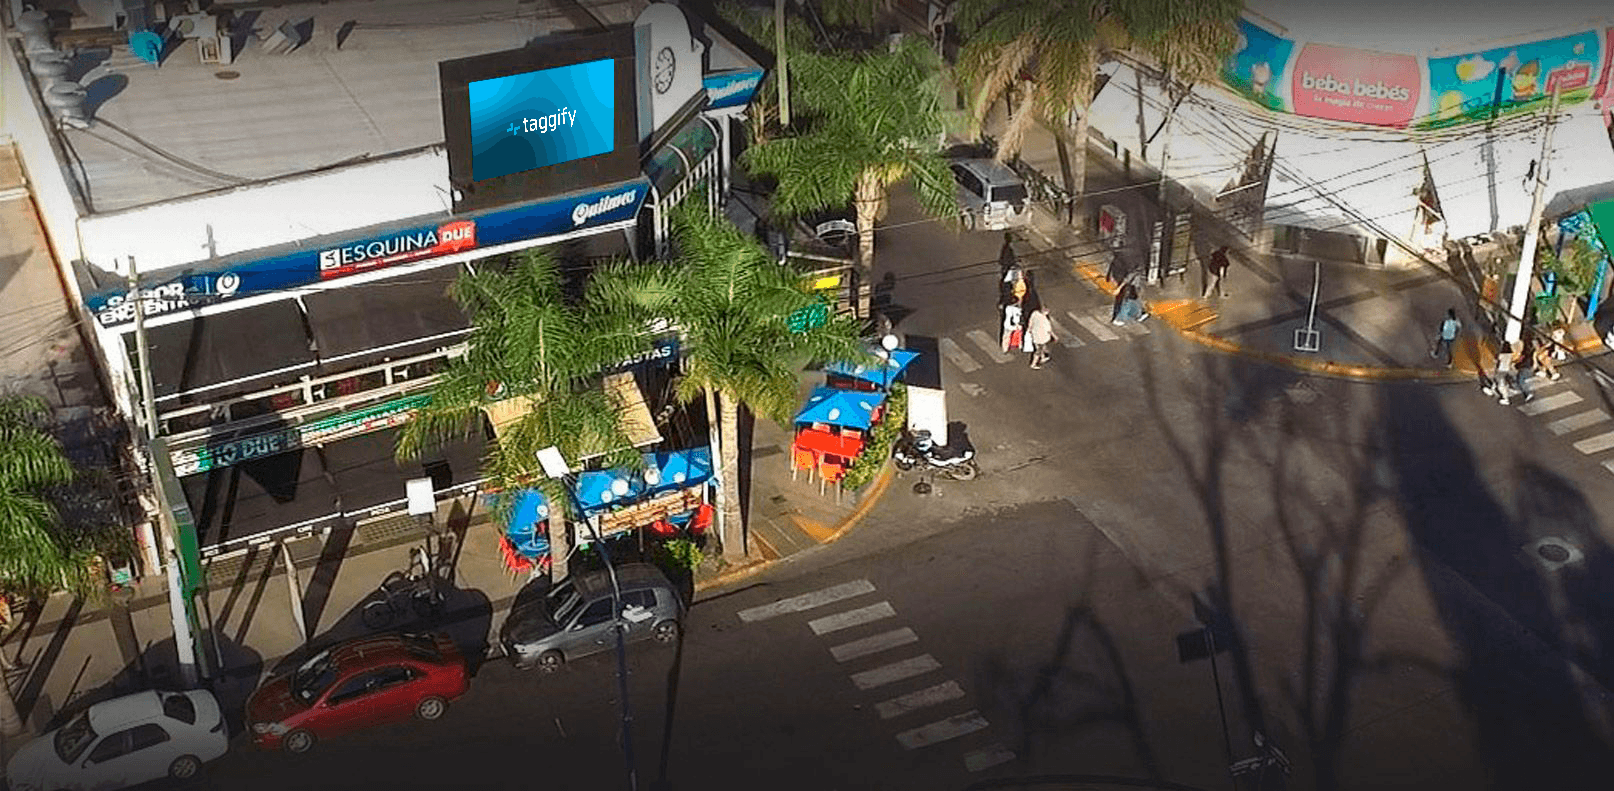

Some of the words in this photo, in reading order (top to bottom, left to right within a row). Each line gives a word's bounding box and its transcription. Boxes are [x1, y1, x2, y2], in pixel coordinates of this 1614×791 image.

[522, 106, 577, 133] taggify
[571, 189, 637, 226] Quilmes
[341, 230, 439, 264] ESQUINA
[441, 226, 472, 243] DUE
